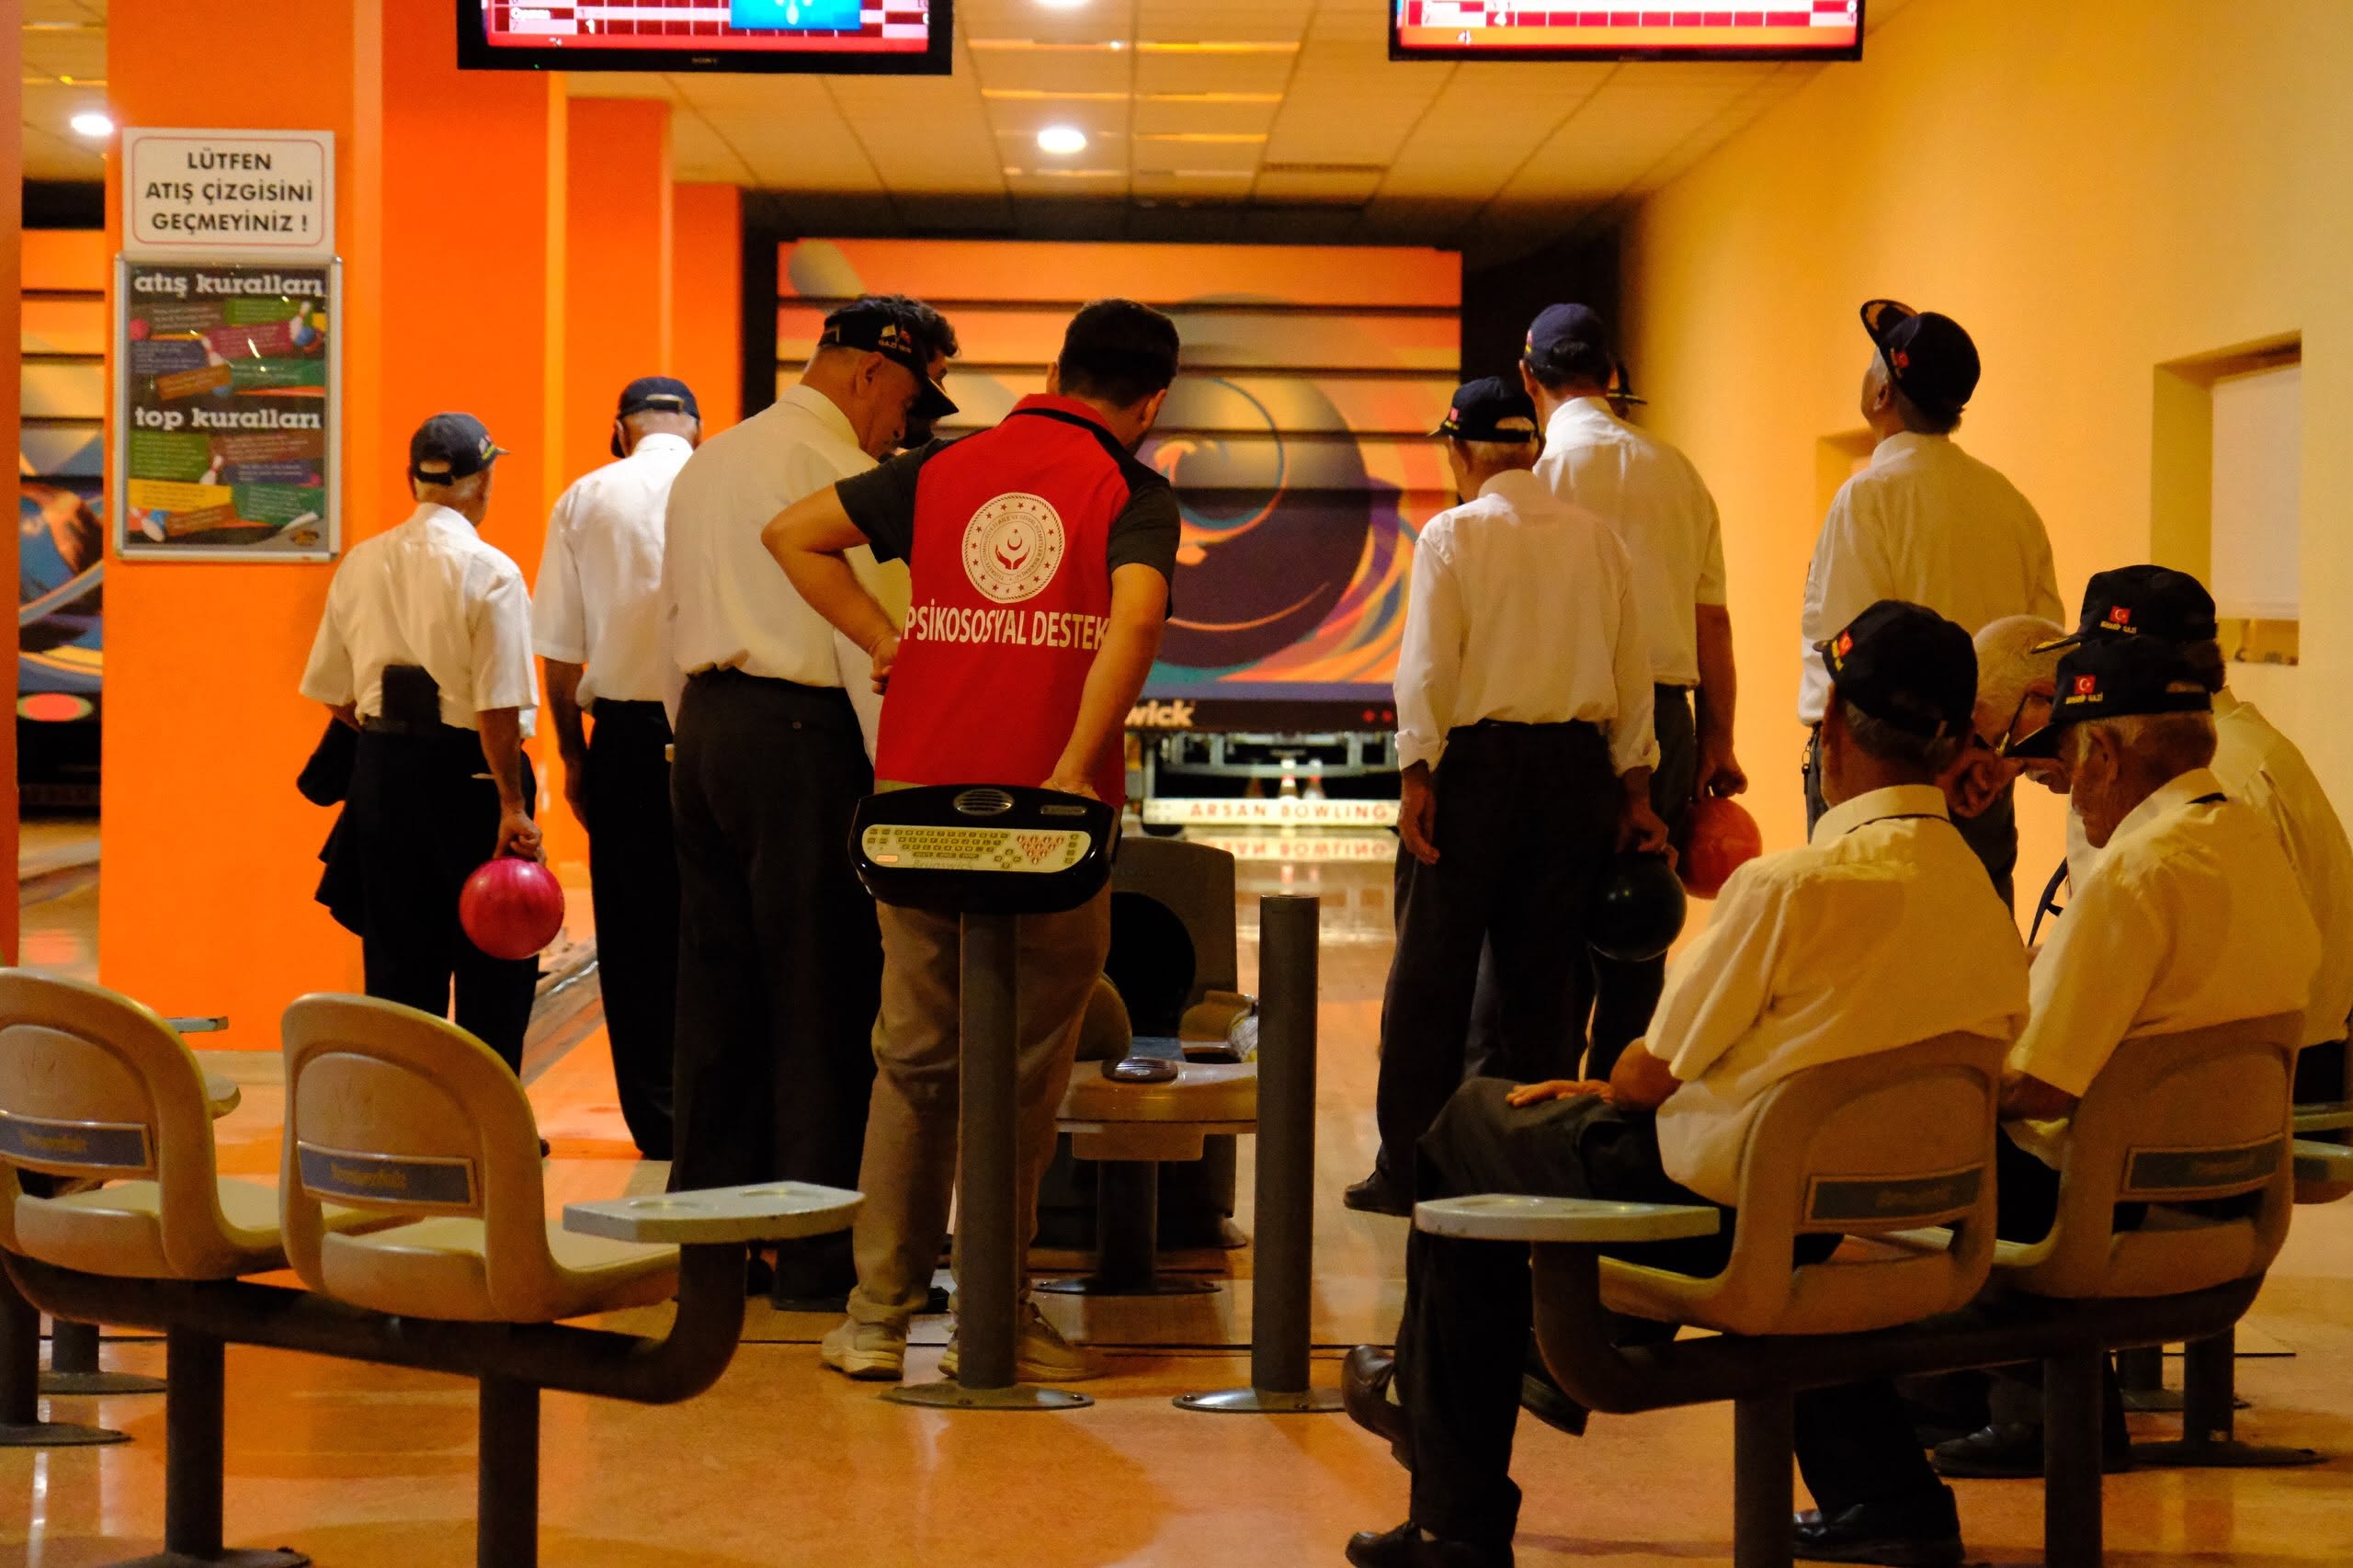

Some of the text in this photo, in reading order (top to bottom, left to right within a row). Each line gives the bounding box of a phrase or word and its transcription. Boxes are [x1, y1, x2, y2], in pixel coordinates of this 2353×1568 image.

[187, 147, 272, 170] LÜTFEN
[145, 177, 313, 206] ATIŞ ÇİZGİSİNİ
[152, 210, 293, 234] GEÇMEYİNİZ
[133, 272, 324, 299] atış kuralları
[134, 406, 322, 431] top kuralları
[904, 598, 1110, 651] PSİKOSOSYAL DESTEK
[1124, 699, 1194, 727] wick
[1190, 802, 1267, 817] ARSAN
[1279, 803, 1388, 820] BOWLING
